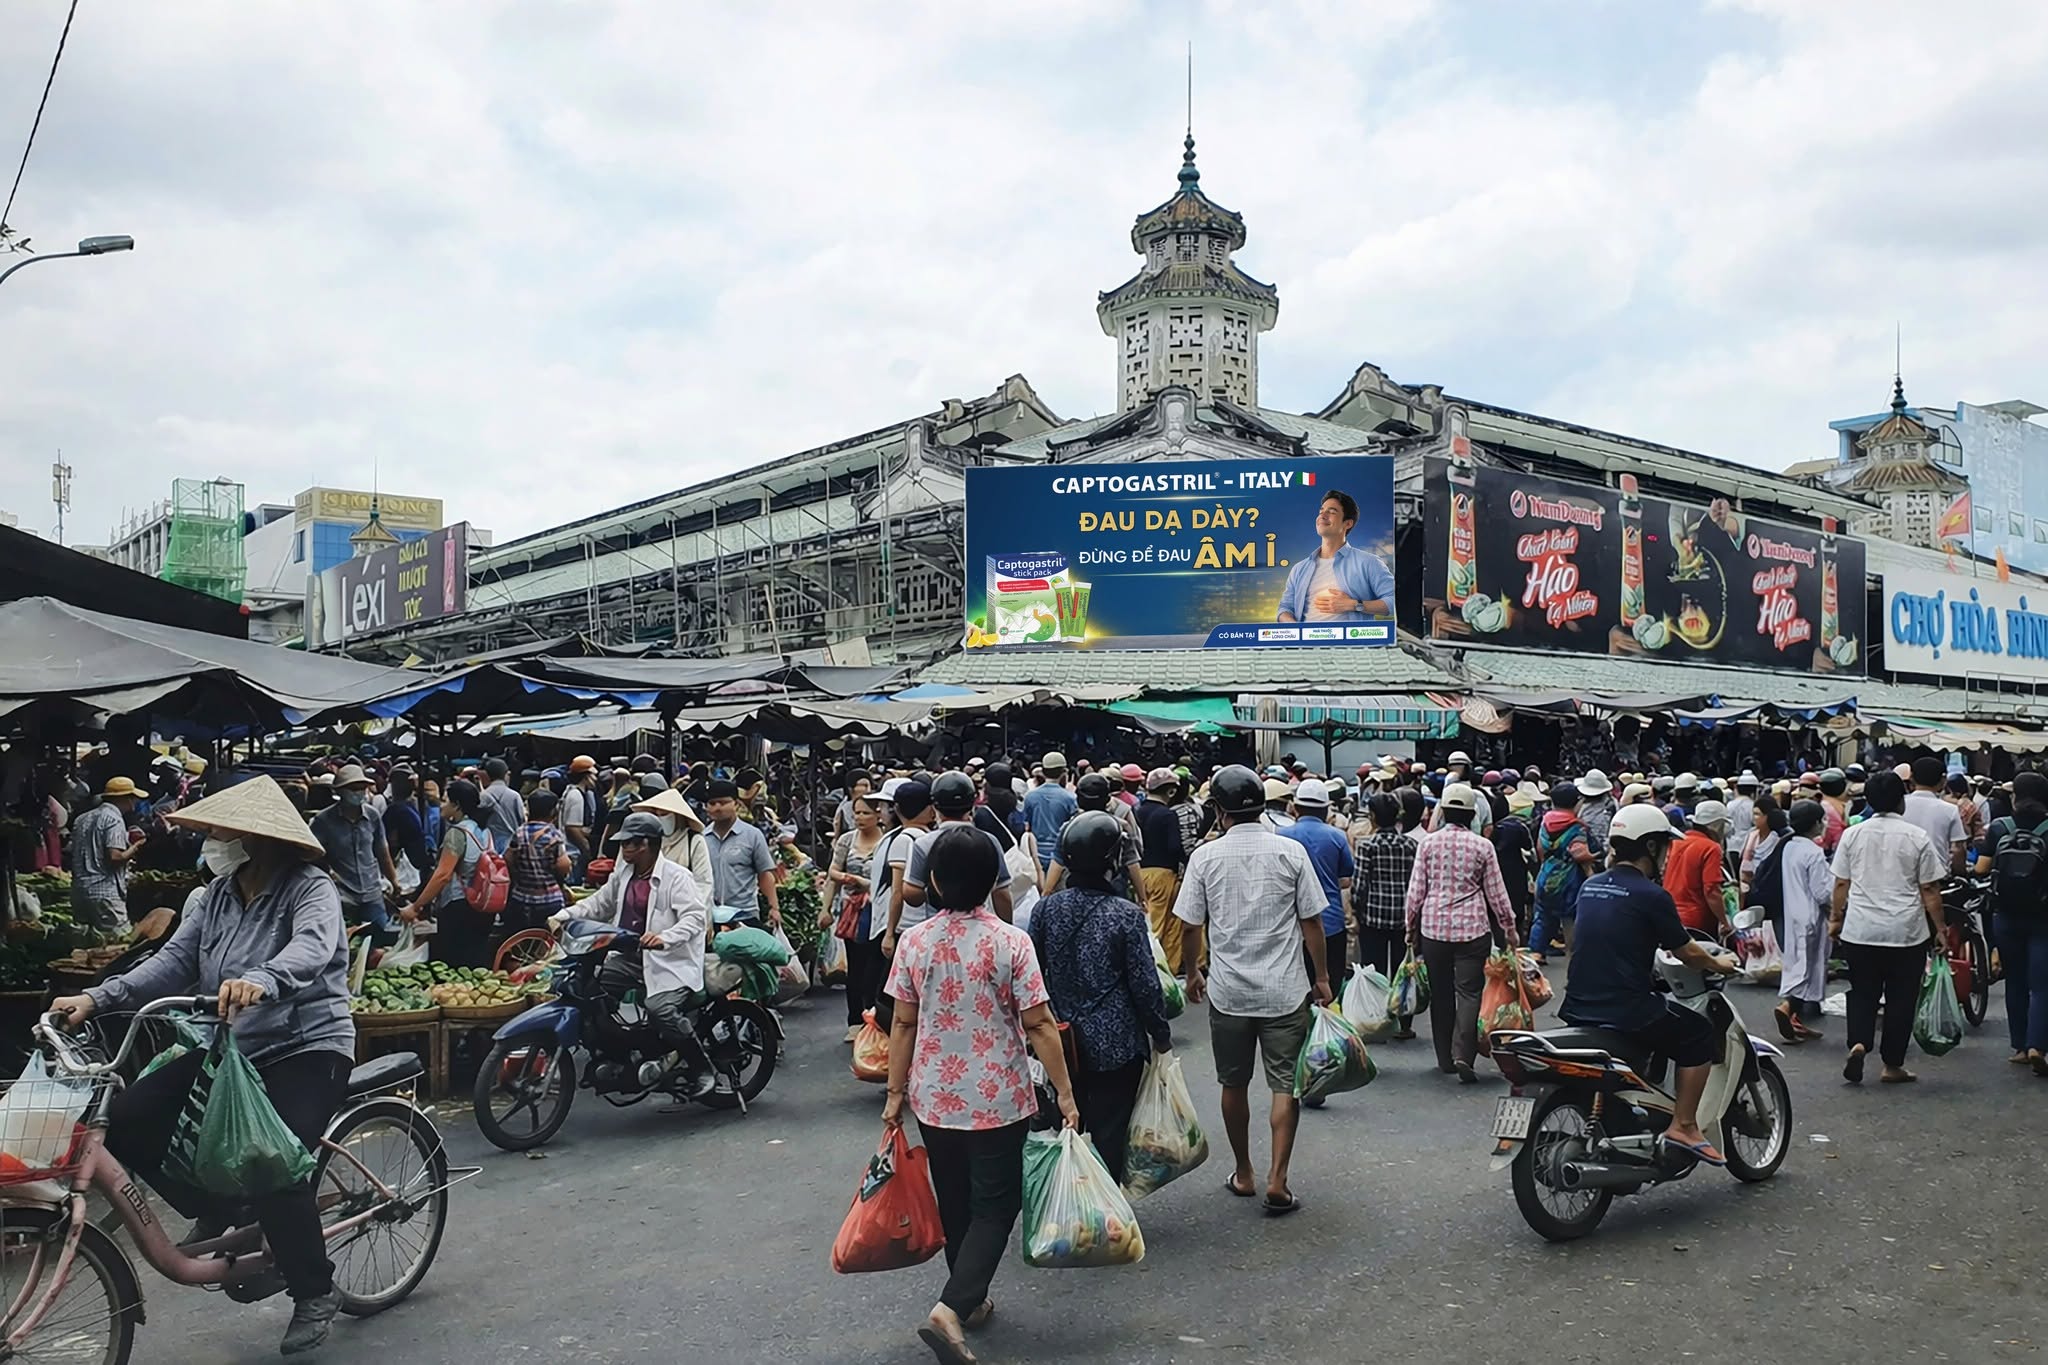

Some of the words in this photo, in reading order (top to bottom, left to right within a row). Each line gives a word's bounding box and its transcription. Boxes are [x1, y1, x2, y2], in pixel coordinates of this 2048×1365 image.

[1239, 472, 1294, 489] ITALY
[1079, 510, 1135, 532] ĐAU
[1145, 509, 1183, 536] DẠ
[1192, 503, 1260, 529] DÀY?
[1079, 547, 1127, 564] ĐỪNG
[1132, 544, 1154, 563] ĐỂ
[1158, 548, 1191, 562] ĐAU
[1013, 569, 1032, 577] stick
[1033, 568, 1052, 579] pack
[1523, 554, 1576, 606] Hào
[1891, 589, 1945, 660] CHỢ
[1950, 586, 2003, 654] HÒA
